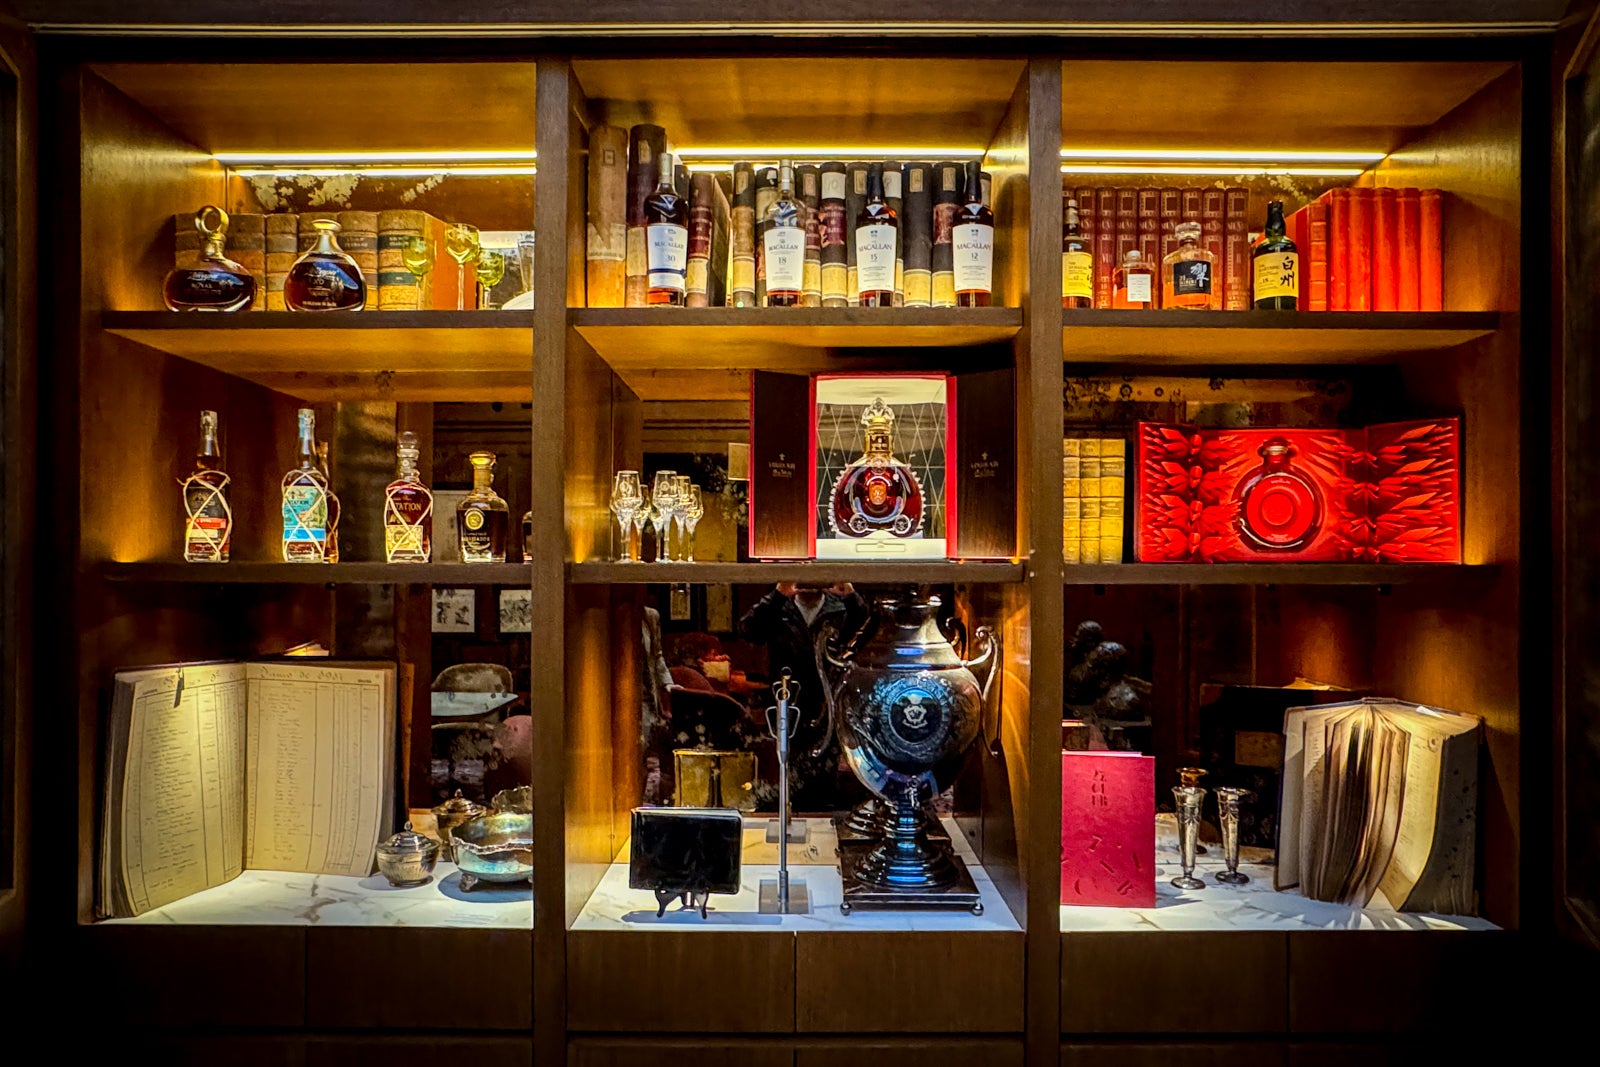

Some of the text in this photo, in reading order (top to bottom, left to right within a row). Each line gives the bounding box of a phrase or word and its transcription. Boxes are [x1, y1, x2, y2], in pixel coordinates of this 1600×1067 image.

[768, 243, 799, 251] MACALLAN
[858, 243, 892, 252] MACALLAN
[956, 242, 991, 250] MACALLAN
[971, 252, 979, 260] 12
[778, 256, 787, 265] 18
[1280, 255, 1294, 290] 白州
